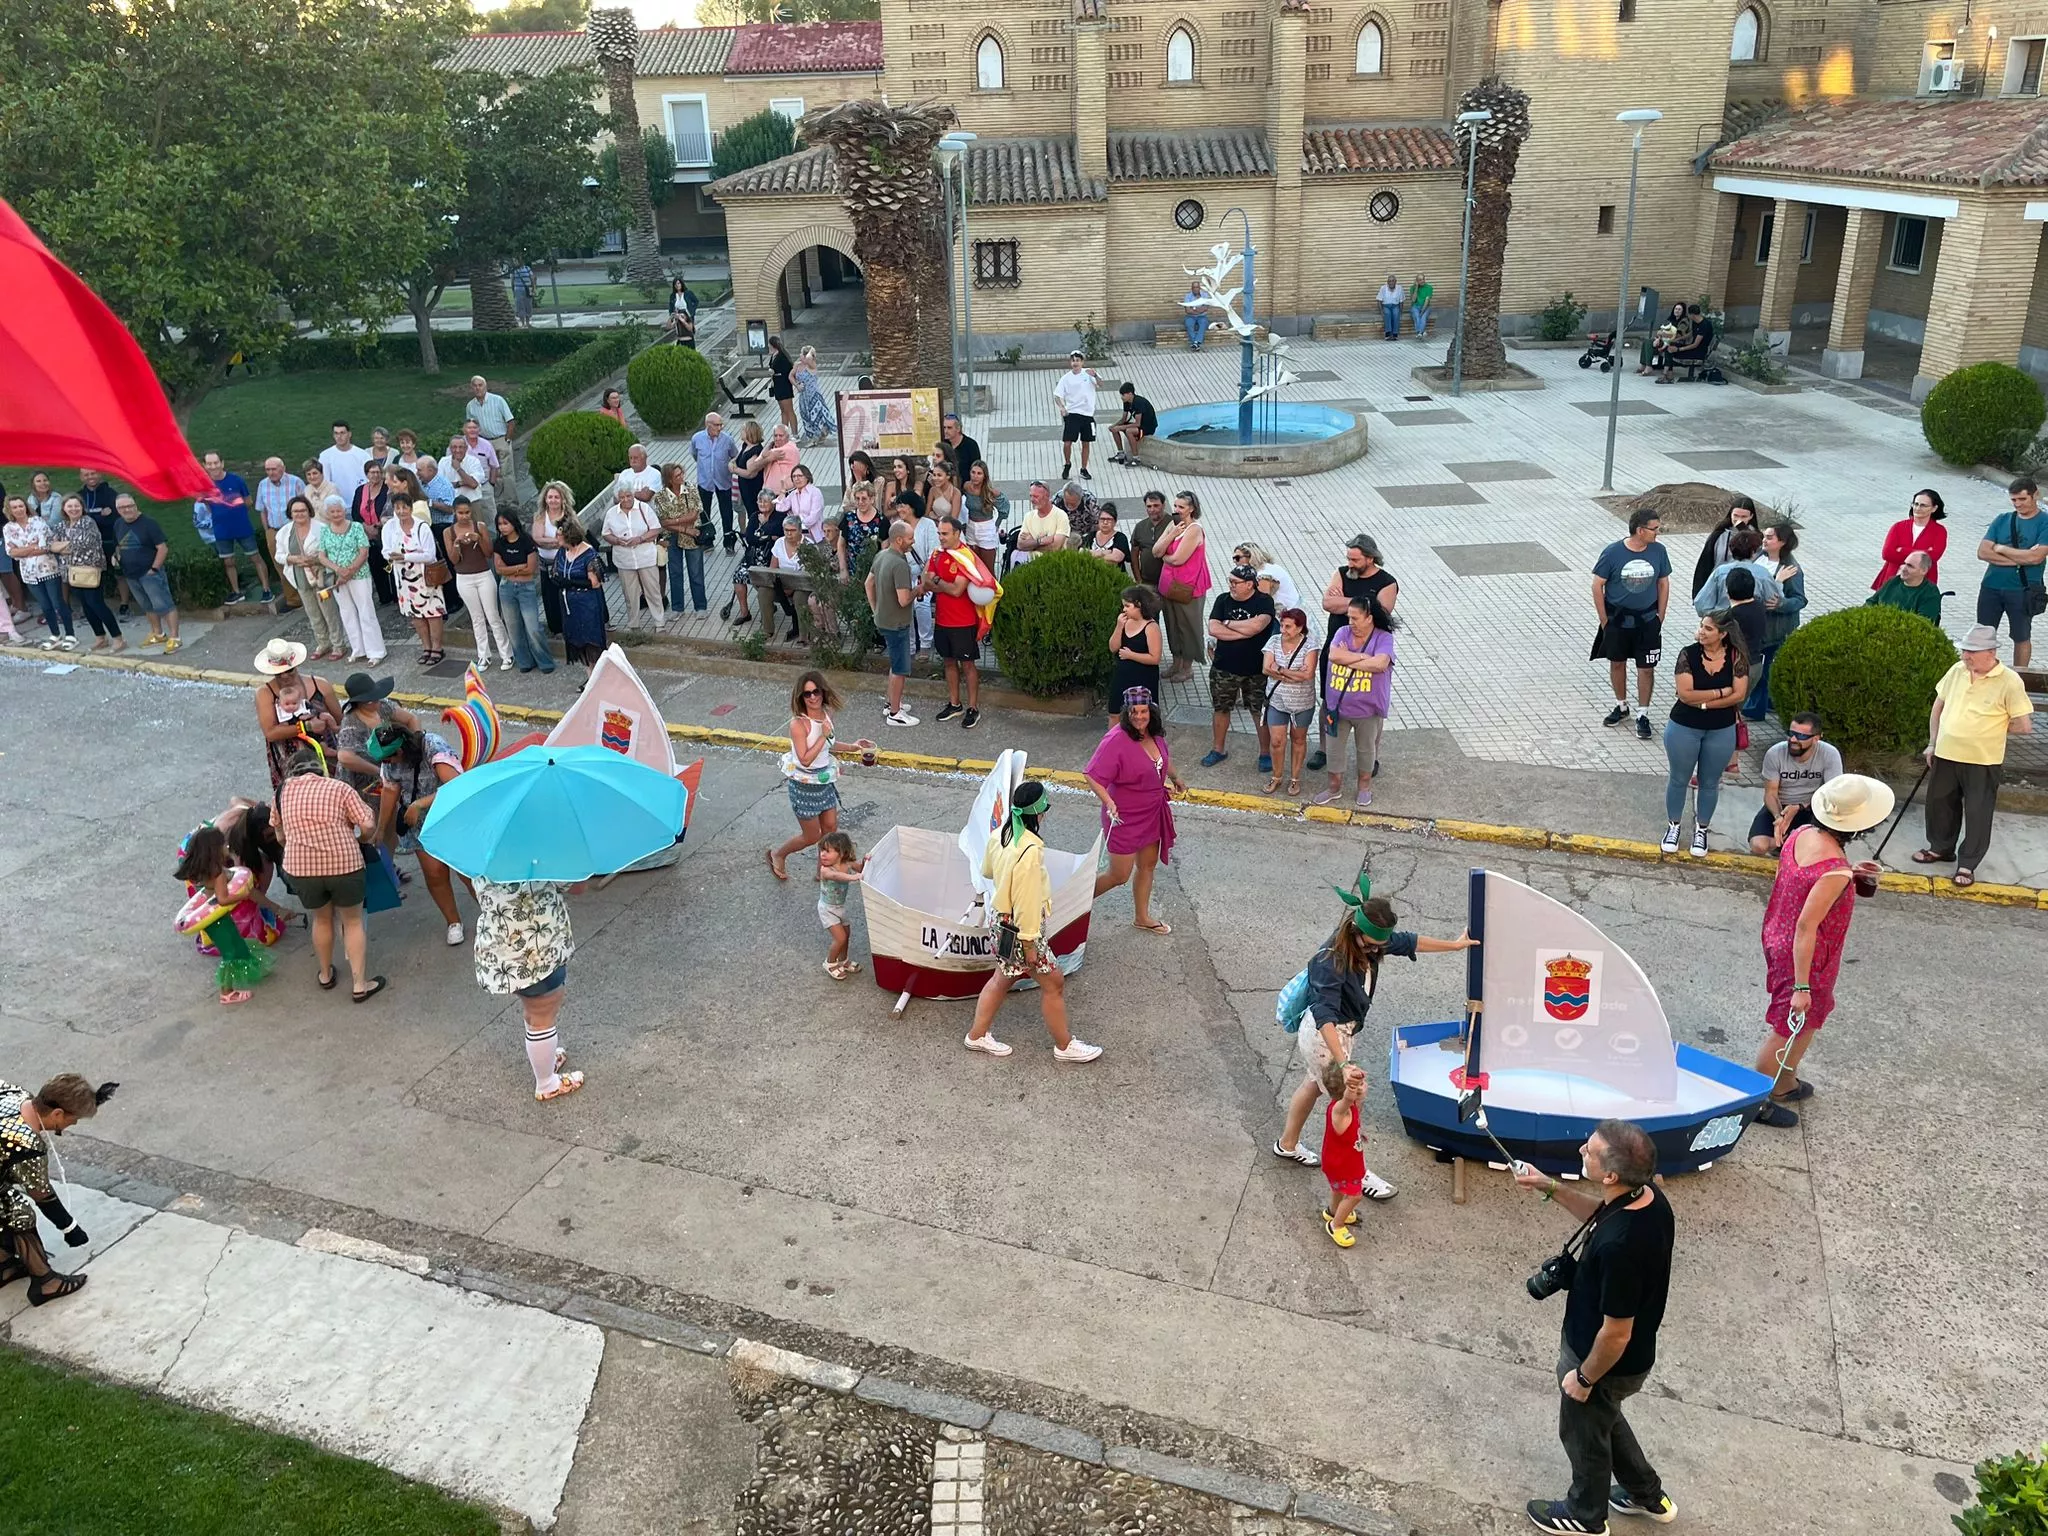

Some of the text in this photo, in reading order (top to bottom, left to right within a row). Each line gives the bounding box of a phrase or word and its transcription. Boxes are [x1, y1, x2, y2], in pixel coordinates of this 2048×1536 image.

[1780, 770, 1822, 780] adidas
[922, 926, 991, 956] LA ASUNC
